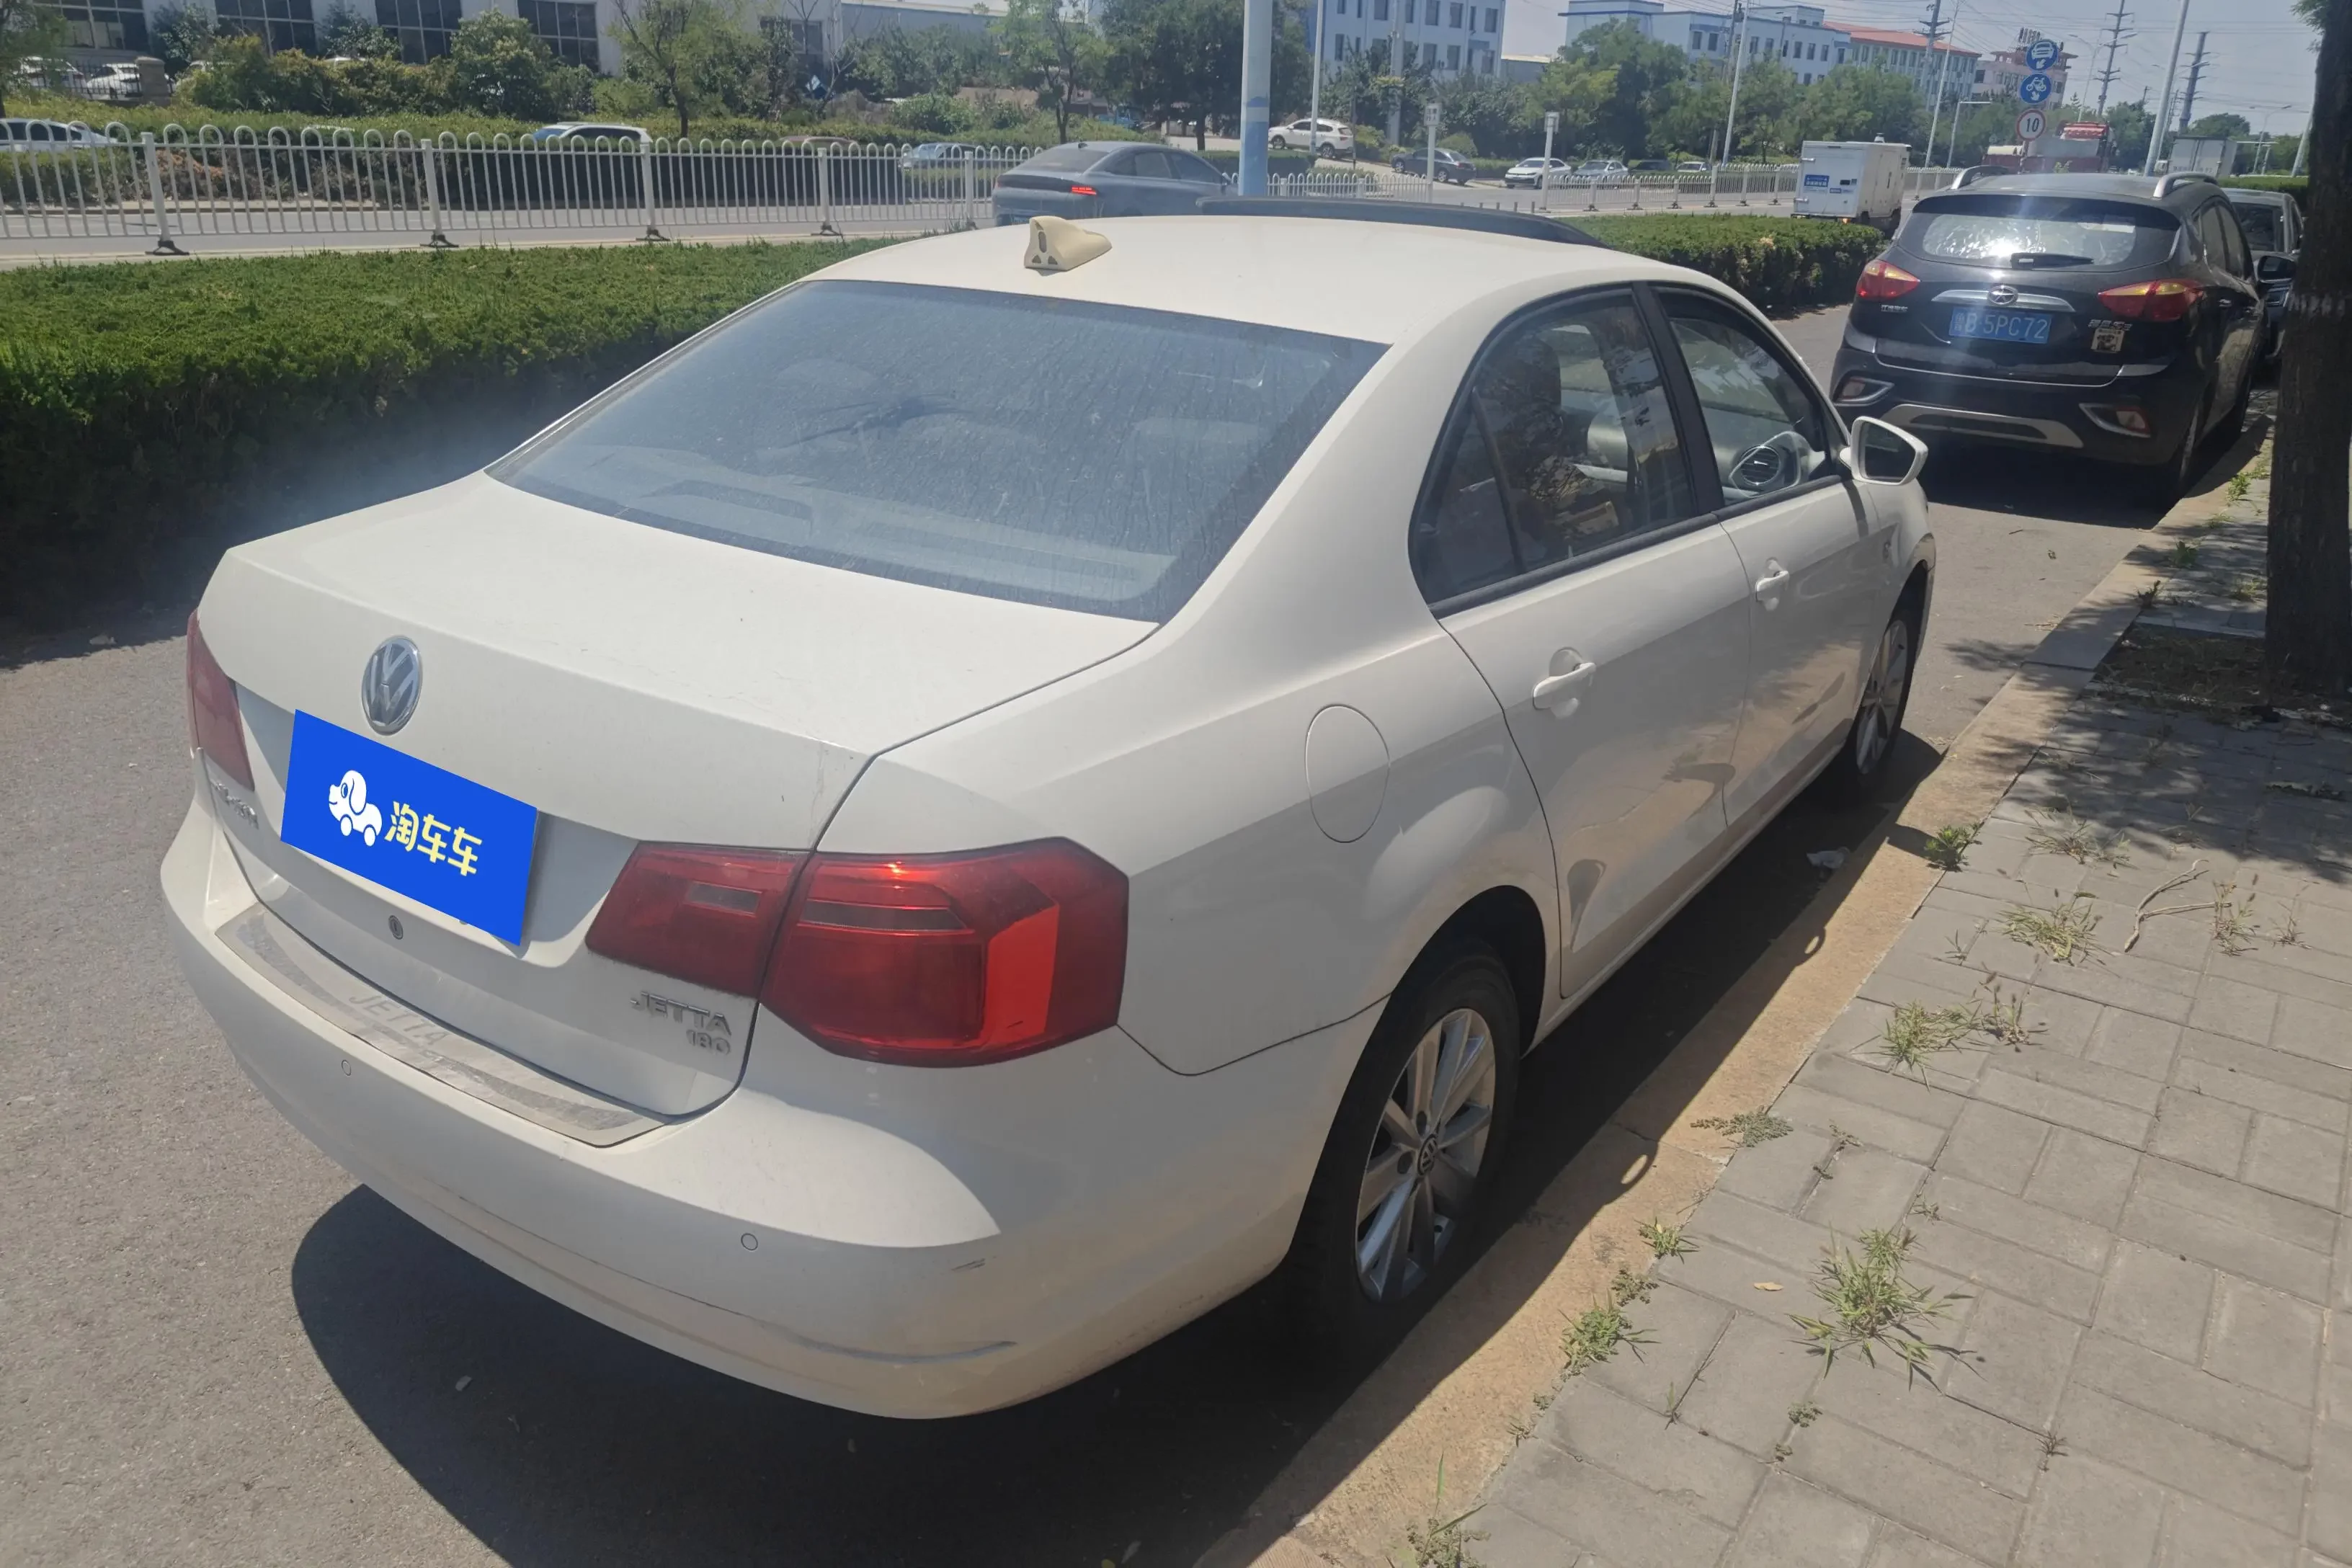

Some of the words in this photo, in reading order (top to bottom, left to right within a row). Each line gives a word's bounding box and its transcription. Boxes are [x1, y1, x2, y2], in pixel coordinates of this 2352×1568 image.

[2026, 117, 2040, 133] 10
[348, 995, 451, 1046] JETTA
[629, 991, 732, 1036] JETTA
[685, 1029, 731, 1056] 180
